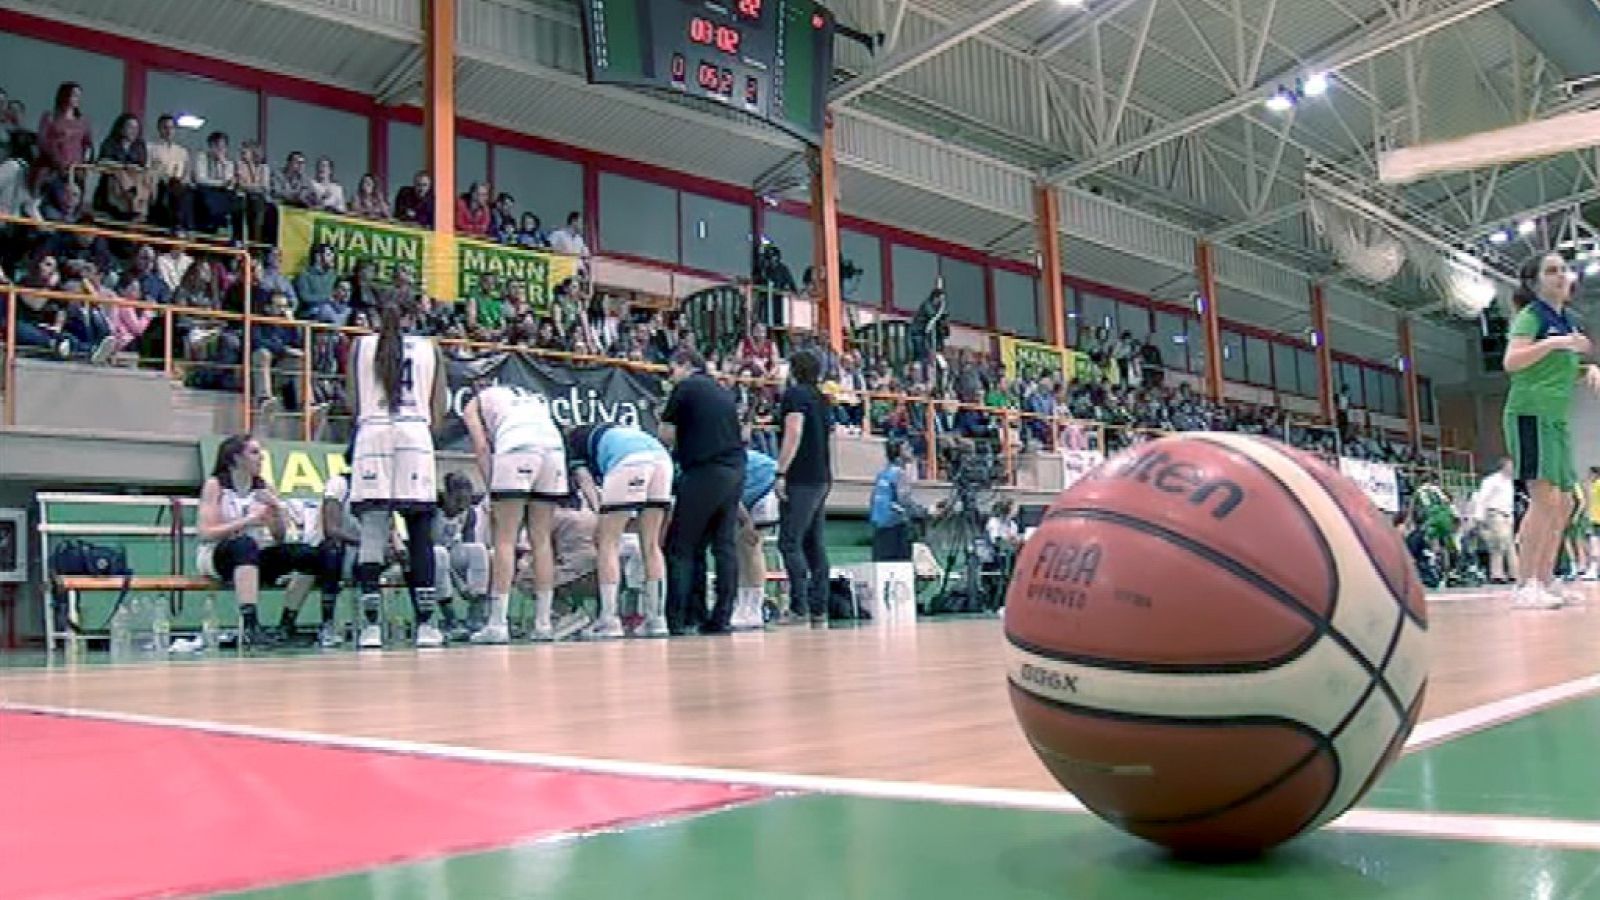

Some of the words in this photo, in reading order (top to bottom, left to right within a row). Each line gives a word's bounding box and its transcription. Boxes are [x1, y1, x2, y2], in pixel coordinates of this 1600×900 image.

[320, 224, 417, 260] MANN
[463, 249, 544, 282] MANN
[1031, 542, 1101, 587] FIBA
